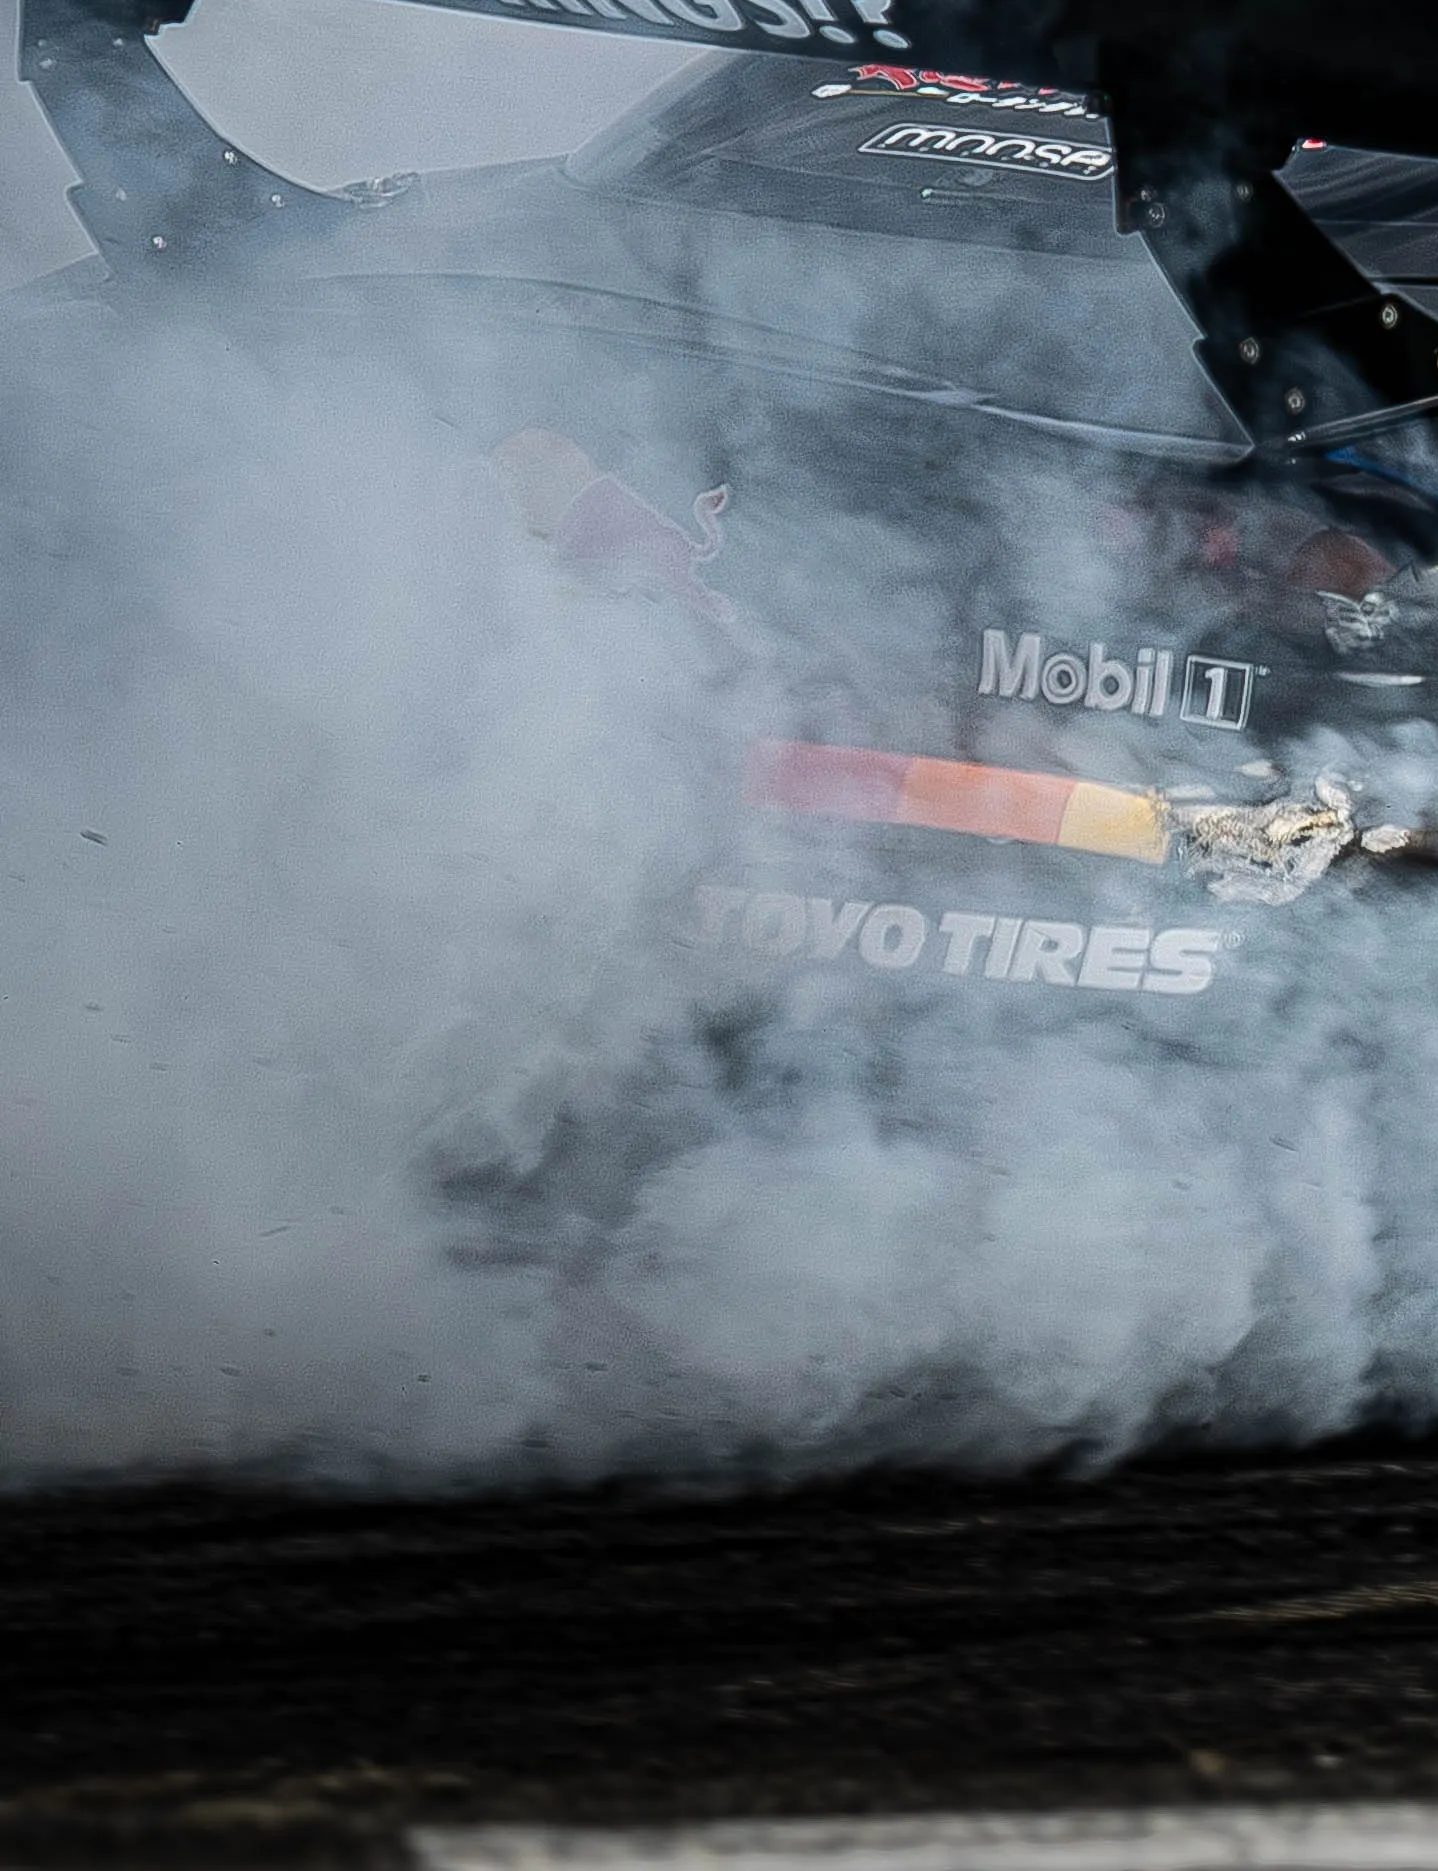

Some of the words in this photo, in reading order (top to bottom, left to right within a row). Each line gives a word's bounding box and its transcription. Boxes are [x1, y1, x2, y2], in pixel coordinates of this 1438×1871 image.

[977, 627, 1174, 720] Mobil
[690, 883, 928, 970] TOYO
[936, 911, 1222, 996] TIRES
